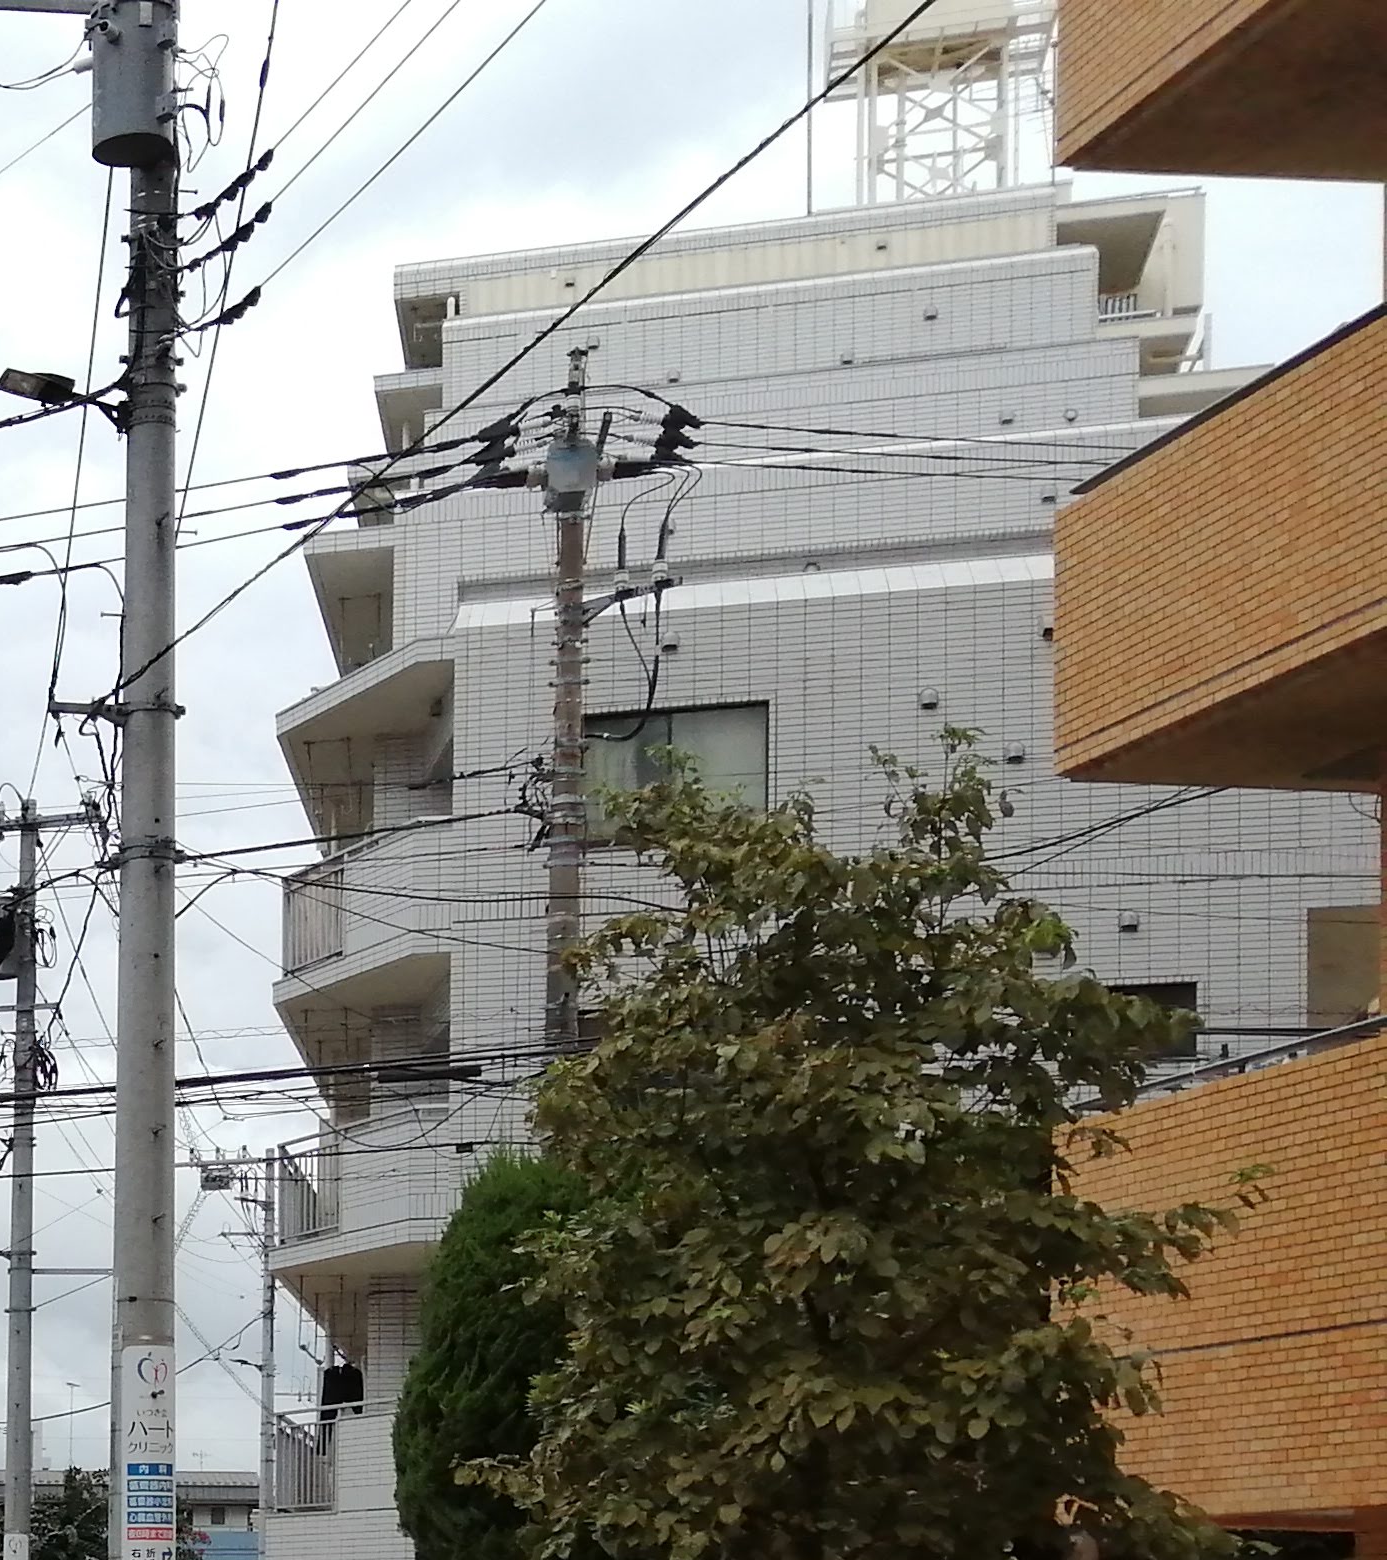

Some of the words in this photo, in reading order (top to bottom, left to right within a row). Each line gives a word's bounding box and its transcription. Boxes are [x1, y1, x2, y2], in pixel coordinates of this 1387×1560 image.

[127, 1420, 174, 1439] ハート
[127, 1441, 174, 1455] クリニック
[138, 1464, 167, 1475] 内科
[131, 1547, 156, 1558] 右折
